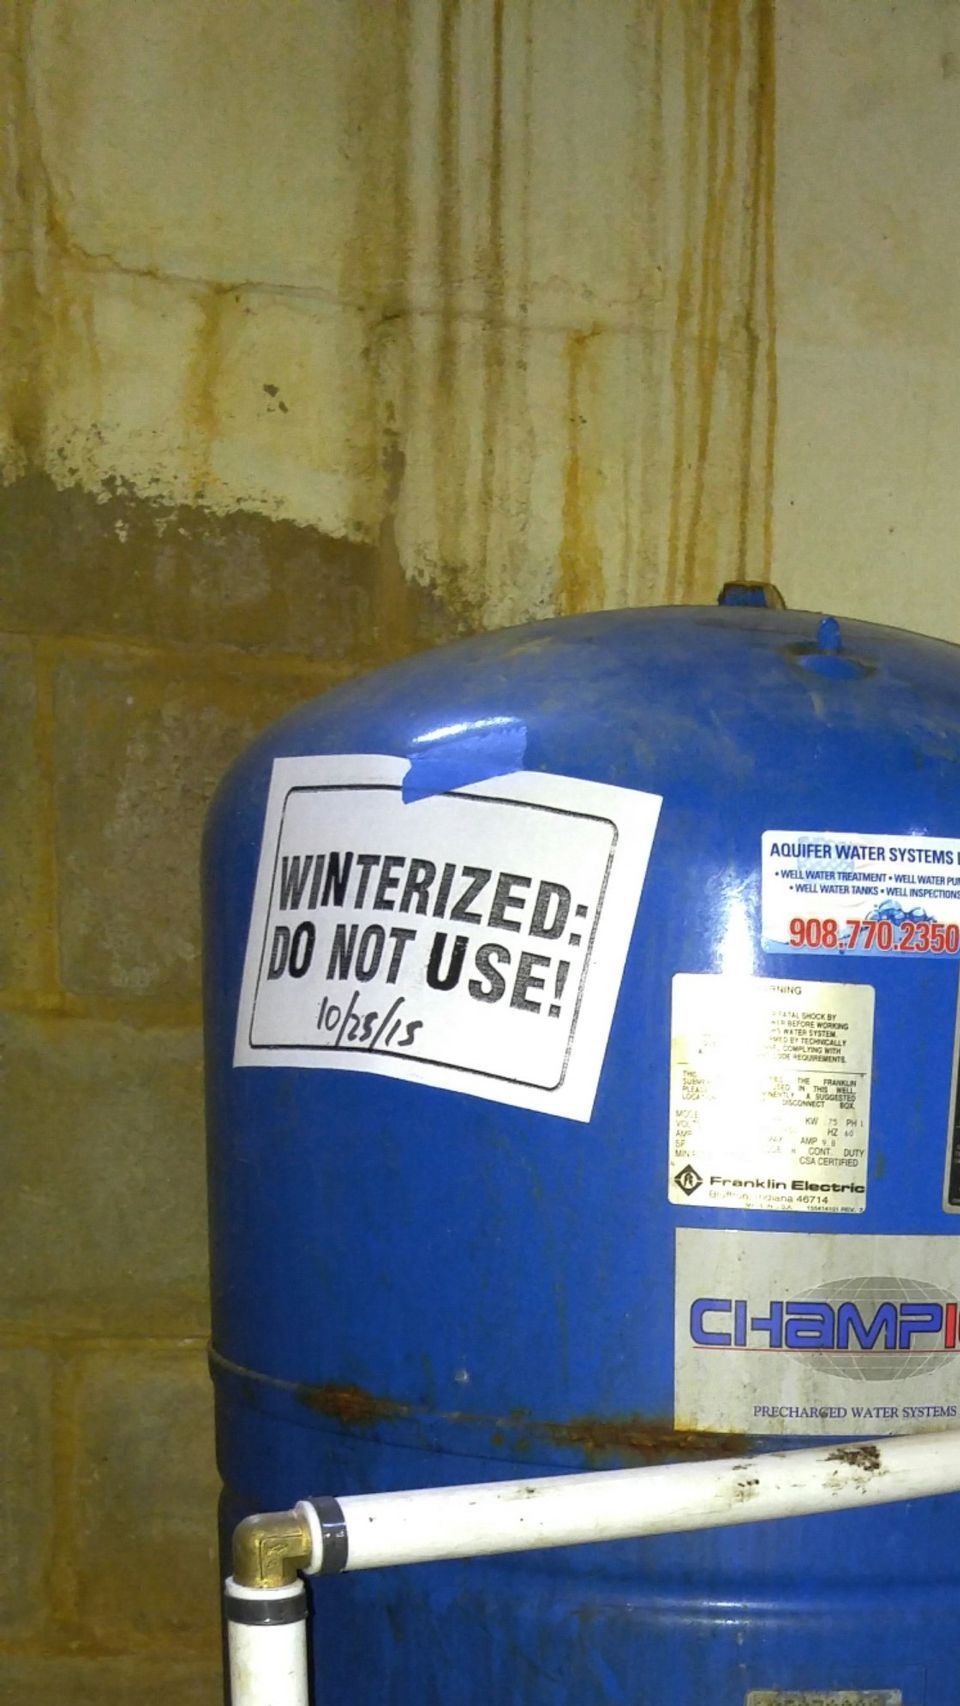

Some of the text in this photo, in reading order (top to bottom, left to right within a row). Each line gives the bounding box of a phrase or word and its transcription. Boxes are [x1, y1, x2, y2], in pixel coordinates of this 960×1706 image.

[770, 842, 831, 859] AQUIFER
[836, 844, 885, 861] WATER
[889, 847, 954, 865] SYSTEMS
[781, 870, 804, 879] WELL
[805, 870, 836, 880] WATER
[837, 871, 887, 882] TREATMENT
[894, 874, 917, 884] WELL
[917, 875, 946, 885] WATER
[795, 884, 818, 893] WELL
[820, 885, 850, 894] WATER
[852, 885, 879, 895] TANKS
[886, 887, 908, 896] WELL
[279, 852, 589, 947] WINTERIZED:
[789, 917, 960, 954] 908.770.2350
[267, 921, 571, 1018] DO NOT USE!
[802, 1012, 826, 1020] SHOCK
[787, 1020, 815, 1028] BEFORE
[816, 1022, 849, 1031] WORKING
[801, 1038, 847, 1047] TECHNICALLY
[783, 1045, 822, 1054] COMPLYING
[825, 1047, 841, 1055] WITH
[797, 1077, 857, 1087] THE FRANKLIN
[813, 1085, 829, 1093] THIS
[815, 1093, 857, 1102] SUGGESTED
[782, 1100, 825, 1108] DISCONNECT
[805, 1117, 819, 1125] KW
[846, 1118, 858, 1127] PH
[827, 1128, 839, 1137] HZ
[843, 1148, 865, 1158] DUTY
[799, 1156, 859, 1168] CSA CERTIFIED
[710, 1176, 865, 1194] Franklin Electric
[796, 1195, 829, 1204] 46714
[753, 1405, 847, 1419] PRECHARGED
[851, 1405, 899, 1419] WATER
[902, 1405, 957, 1418] SYSTEMS
